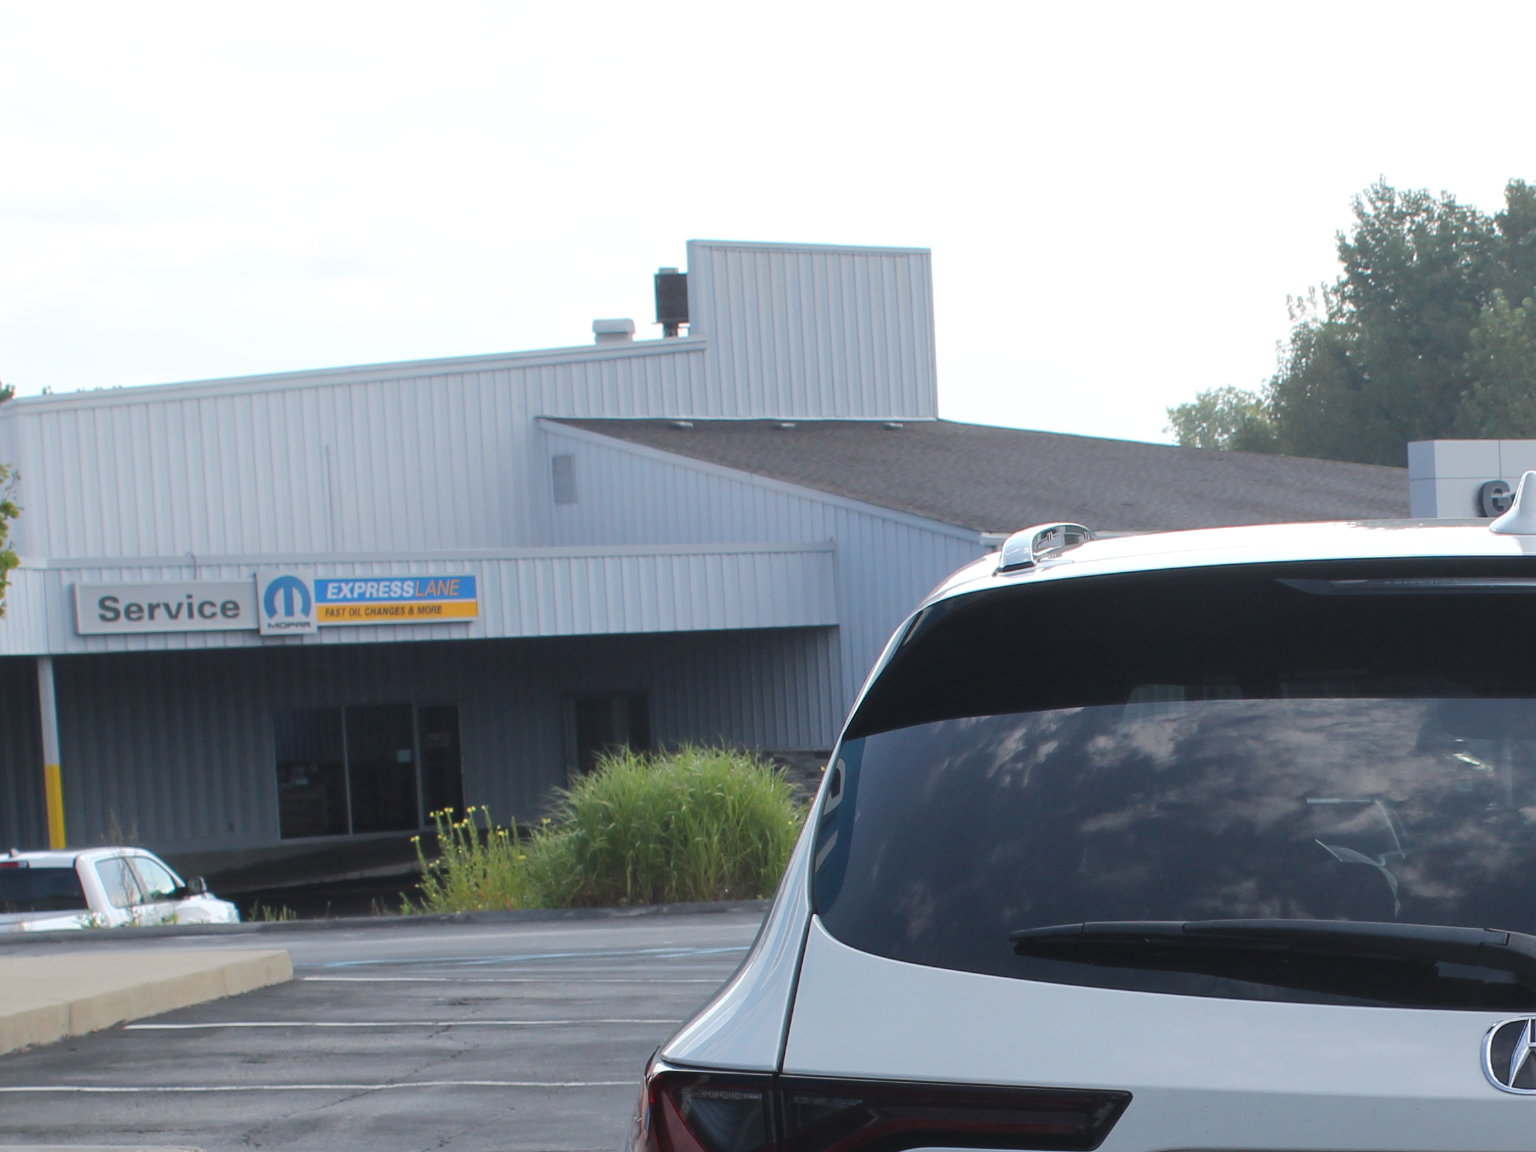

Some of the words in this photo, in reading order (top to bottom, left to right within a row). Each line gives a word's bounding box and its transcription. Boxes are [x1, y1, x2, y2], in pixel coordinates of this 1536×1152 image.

[97, 593, 241, 623] Service
[324, 606, 345, 618] FAST
[349, 606, 362, 617] OIL
[364, 604, 406, 617] CHANGES
[407, 605, 415, 616] &
[417, 604, 443, 616] MORE
[267, 621, 312, 630] MOPAR
